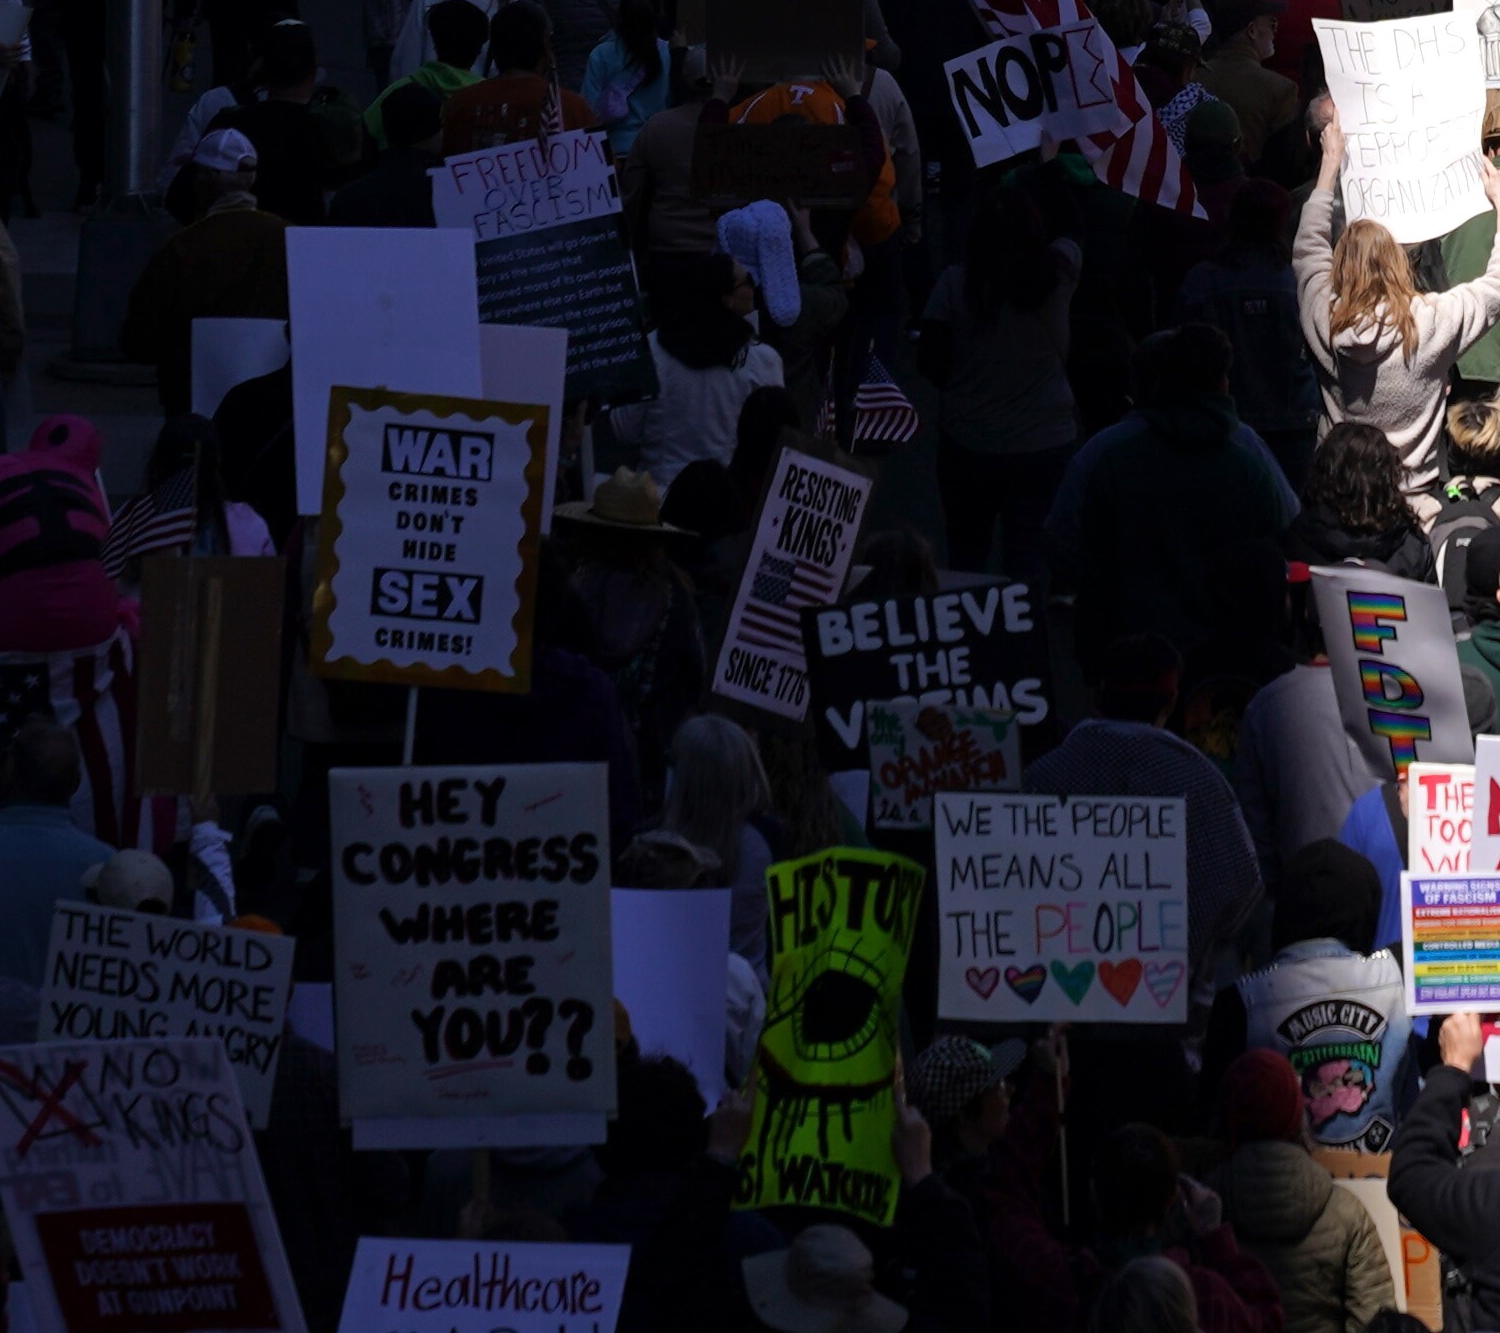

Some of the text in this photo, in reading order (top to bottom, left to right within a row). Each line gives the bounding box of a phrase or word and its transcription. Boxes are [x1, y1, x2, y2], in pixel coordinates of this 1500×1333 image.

[384, 425, 492, 480] WAR
[389, 482, 477, 505] CRIMES
[779, 465, 861, 523] RESISTING
[396, 510, 464, 533] DON'T
[776, 507, 843, 566] KINGS
[403, 541, 456, 562] HIDE
[373, 571, 481, 622] SEX
[817, 583, 1033, 657] BELIEVE
[375, 629, 472, 655] CRIMES!
[889, 647, 971, 685] THE
[724, 648, 808, 704] SINCE 1776
[400, 777, 506, 827] HEY
[944, 802, 1177, 838] WE THE PEOPLE
[343, 834, 599, 885] CONGRESS
[950, 852, 1170, 891] MEANS ALL
[379, 900, 559, 943] WHERE
[948, 900, 1183, 956] THE PEOPLE
[432, 956, 536, 997] ARE
[412, 1001, 593, 1081] YOU??
